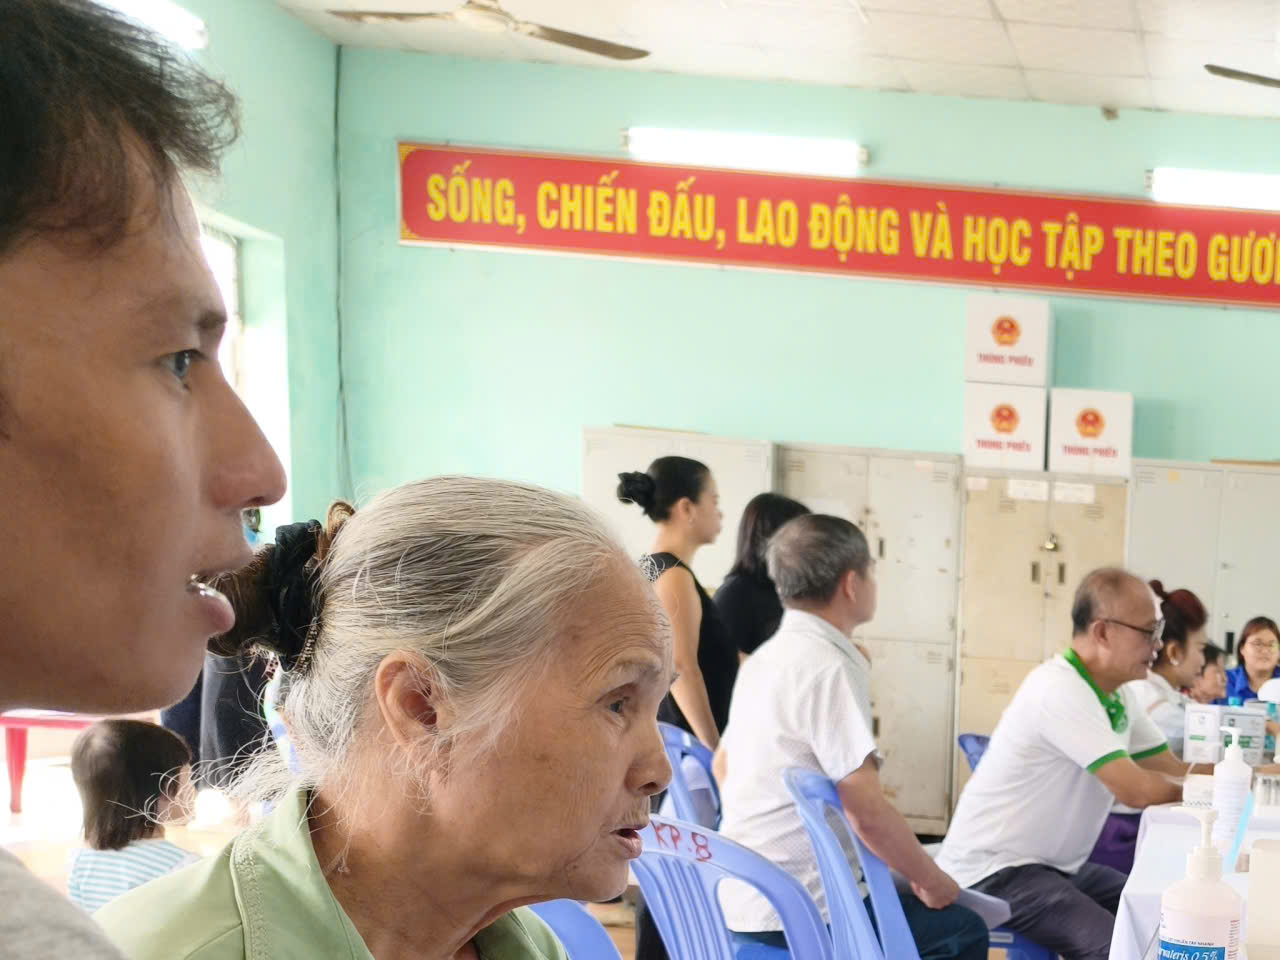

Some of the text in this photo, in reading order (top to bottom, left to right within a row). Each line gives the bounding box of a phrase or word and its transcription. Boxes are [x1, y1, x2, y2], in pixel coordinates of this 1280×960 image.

[427, 160, 527, 235] SỐNG,
[536, 170, 638, 235] CHIẾN
[647, 176, 726, 250] ĐẤU,
[737, 197, 799, 248] LAO
[808, 194, 900, 263] ĐỘNG
[910, 201, 954, 260] VÀ
[963, 216, 1032, 275] HỌC
[1042, 211, 1104, 281] TẬP
[1113, 227, 1198, 280] THEO
